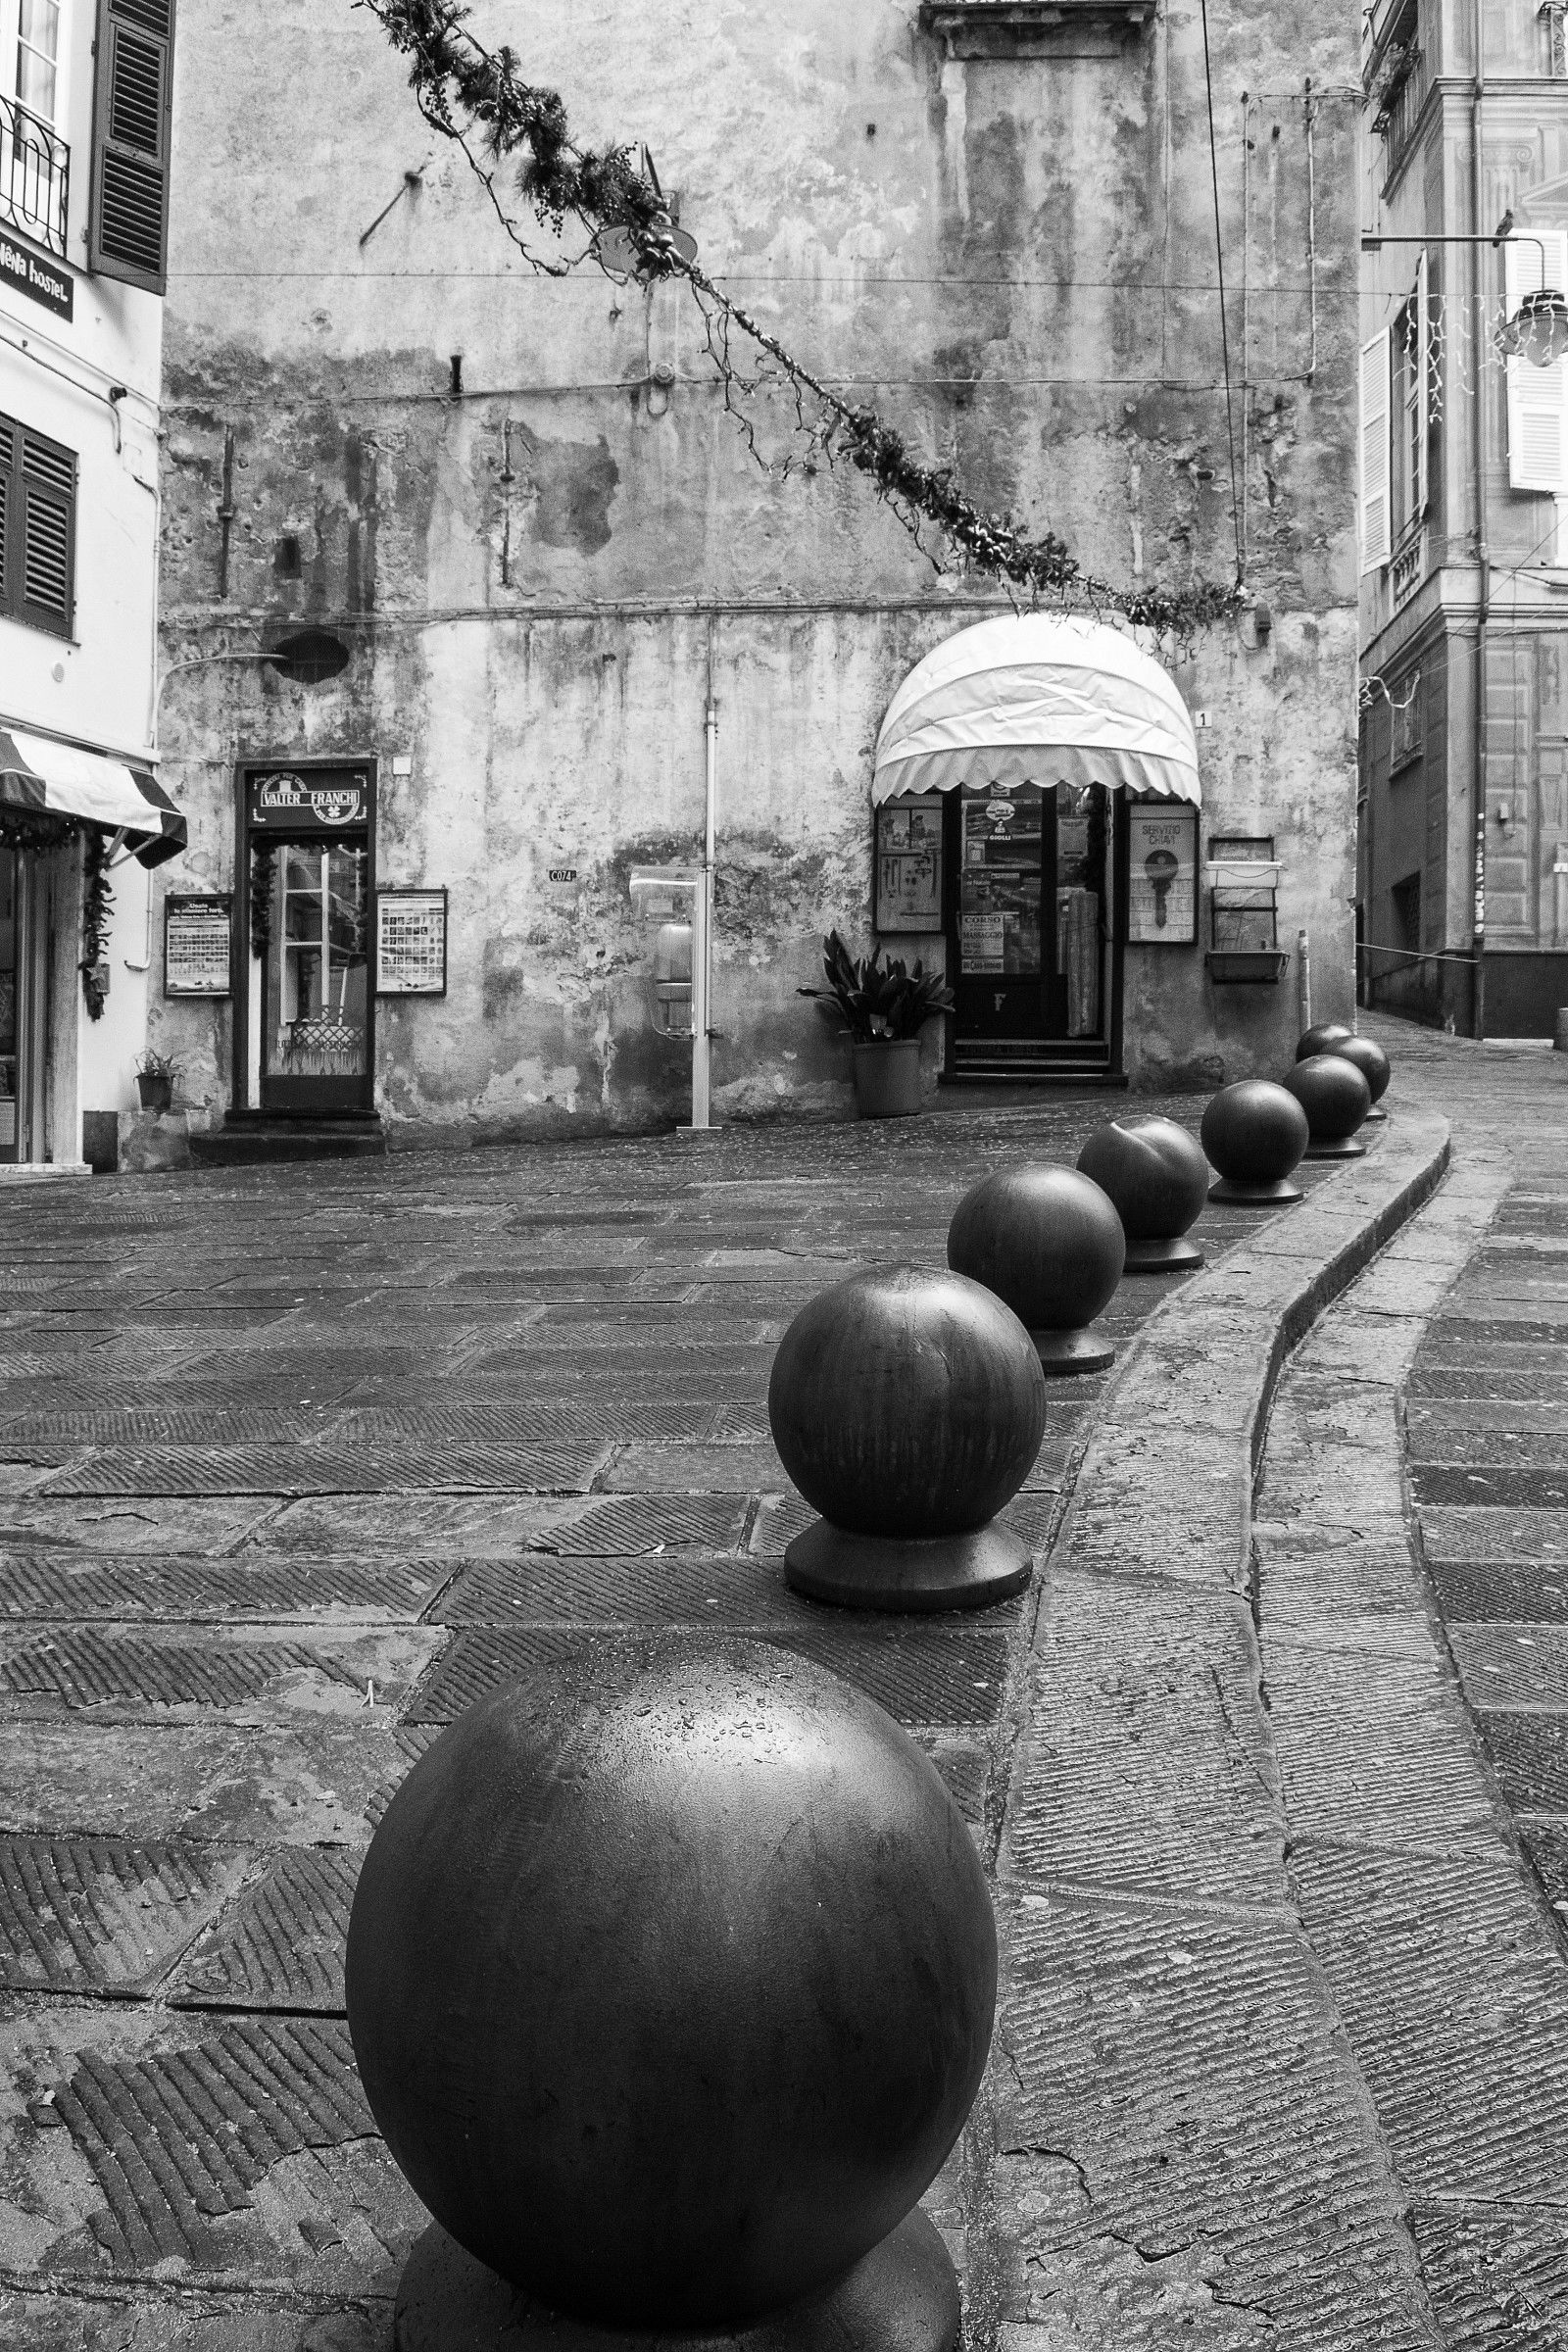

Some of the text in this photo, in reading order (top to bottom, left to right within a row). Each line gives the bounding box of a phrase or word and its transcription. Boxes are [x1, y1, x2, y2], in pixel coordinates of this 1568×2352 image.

[264, 792, 358, 806] VALTER FRANCHI
[551, 870, 571, 881] C074
[993, 993, 1007, 1011] F
